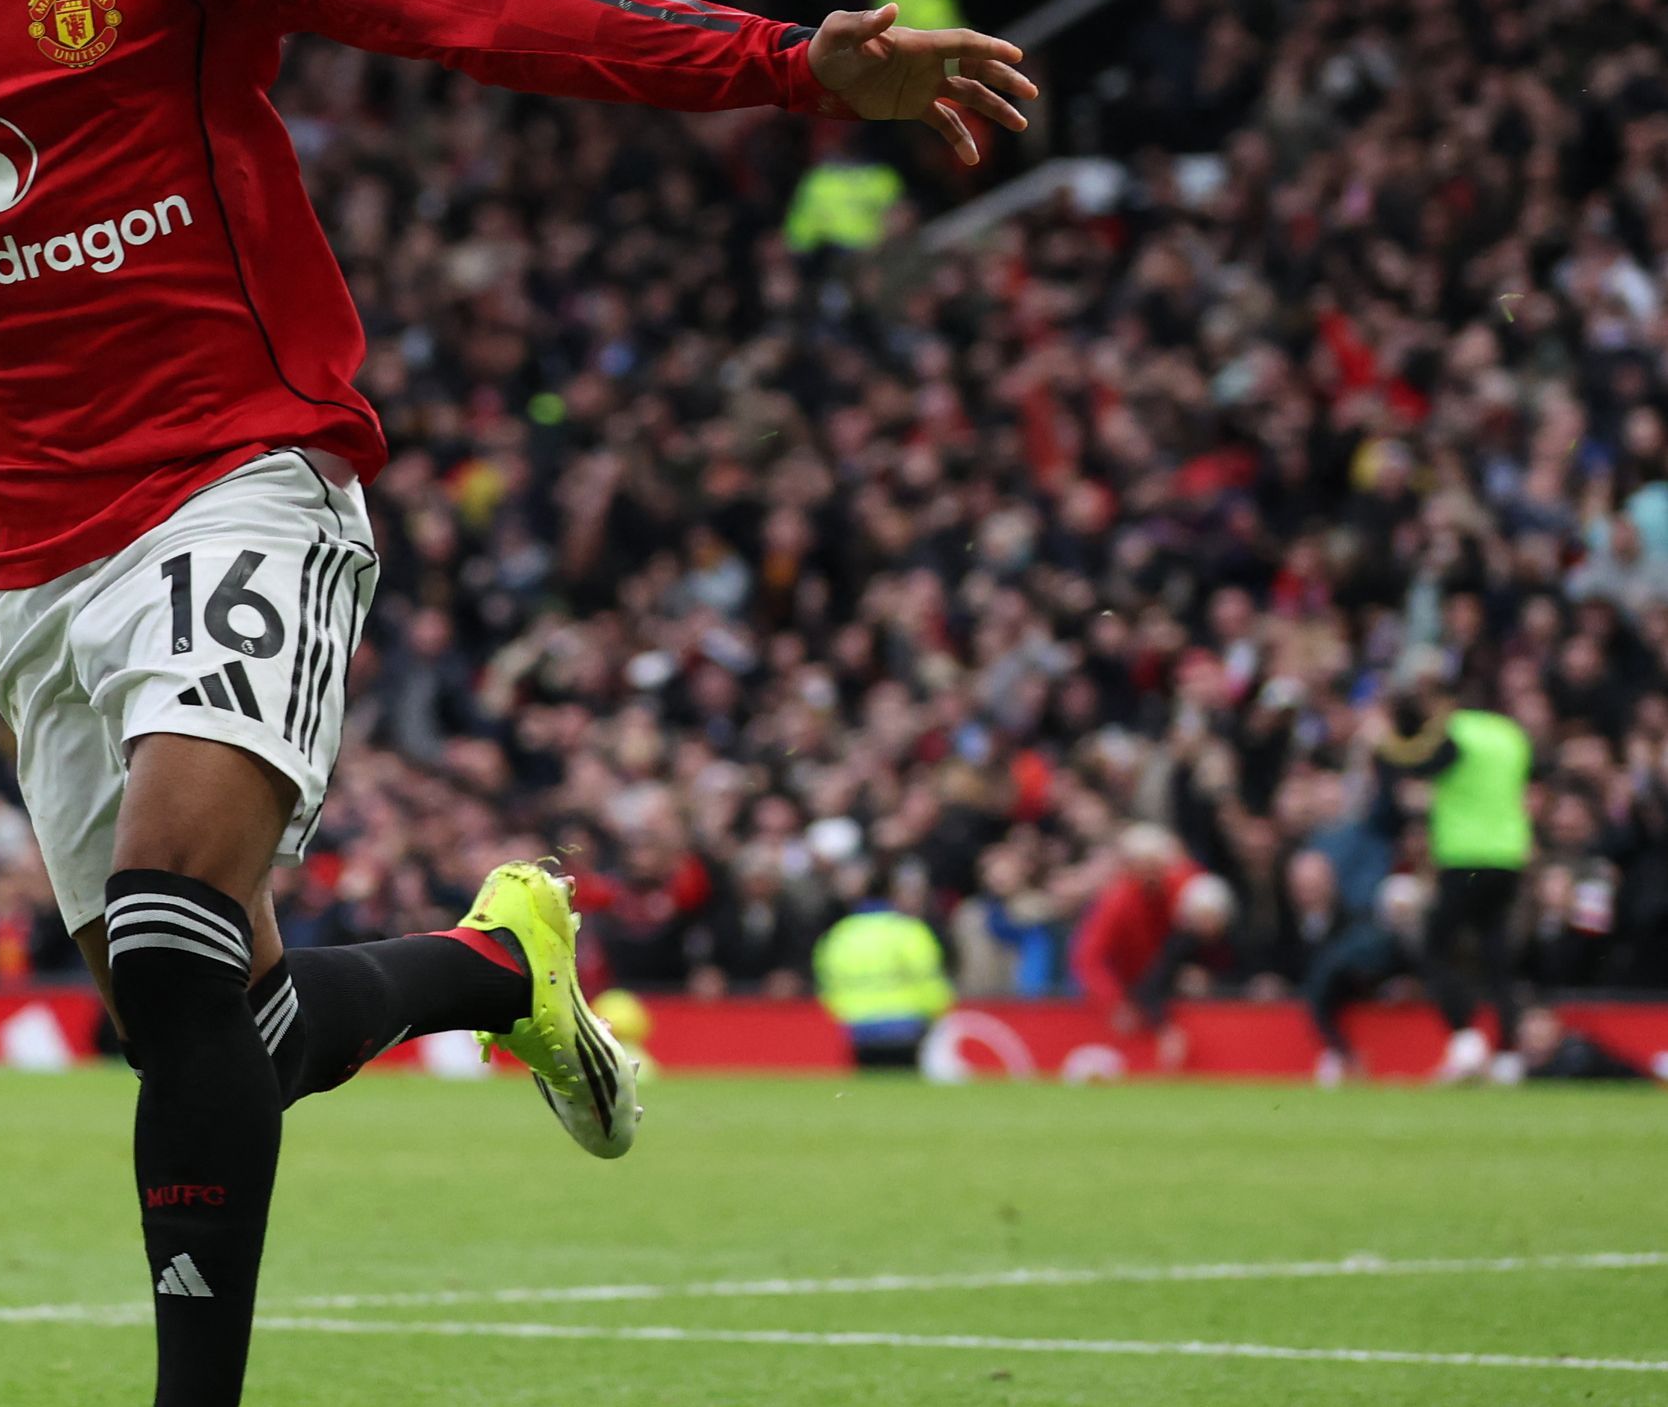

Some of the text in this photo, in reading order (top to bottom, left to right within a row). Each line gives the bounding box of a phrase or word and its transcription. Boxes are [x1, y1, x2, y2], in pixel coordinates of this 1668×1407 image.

[54, 41, 106, 61] UNITED
[160, 549, 285, 659] 16
[147, 1184, 226, 1208] MUFC
